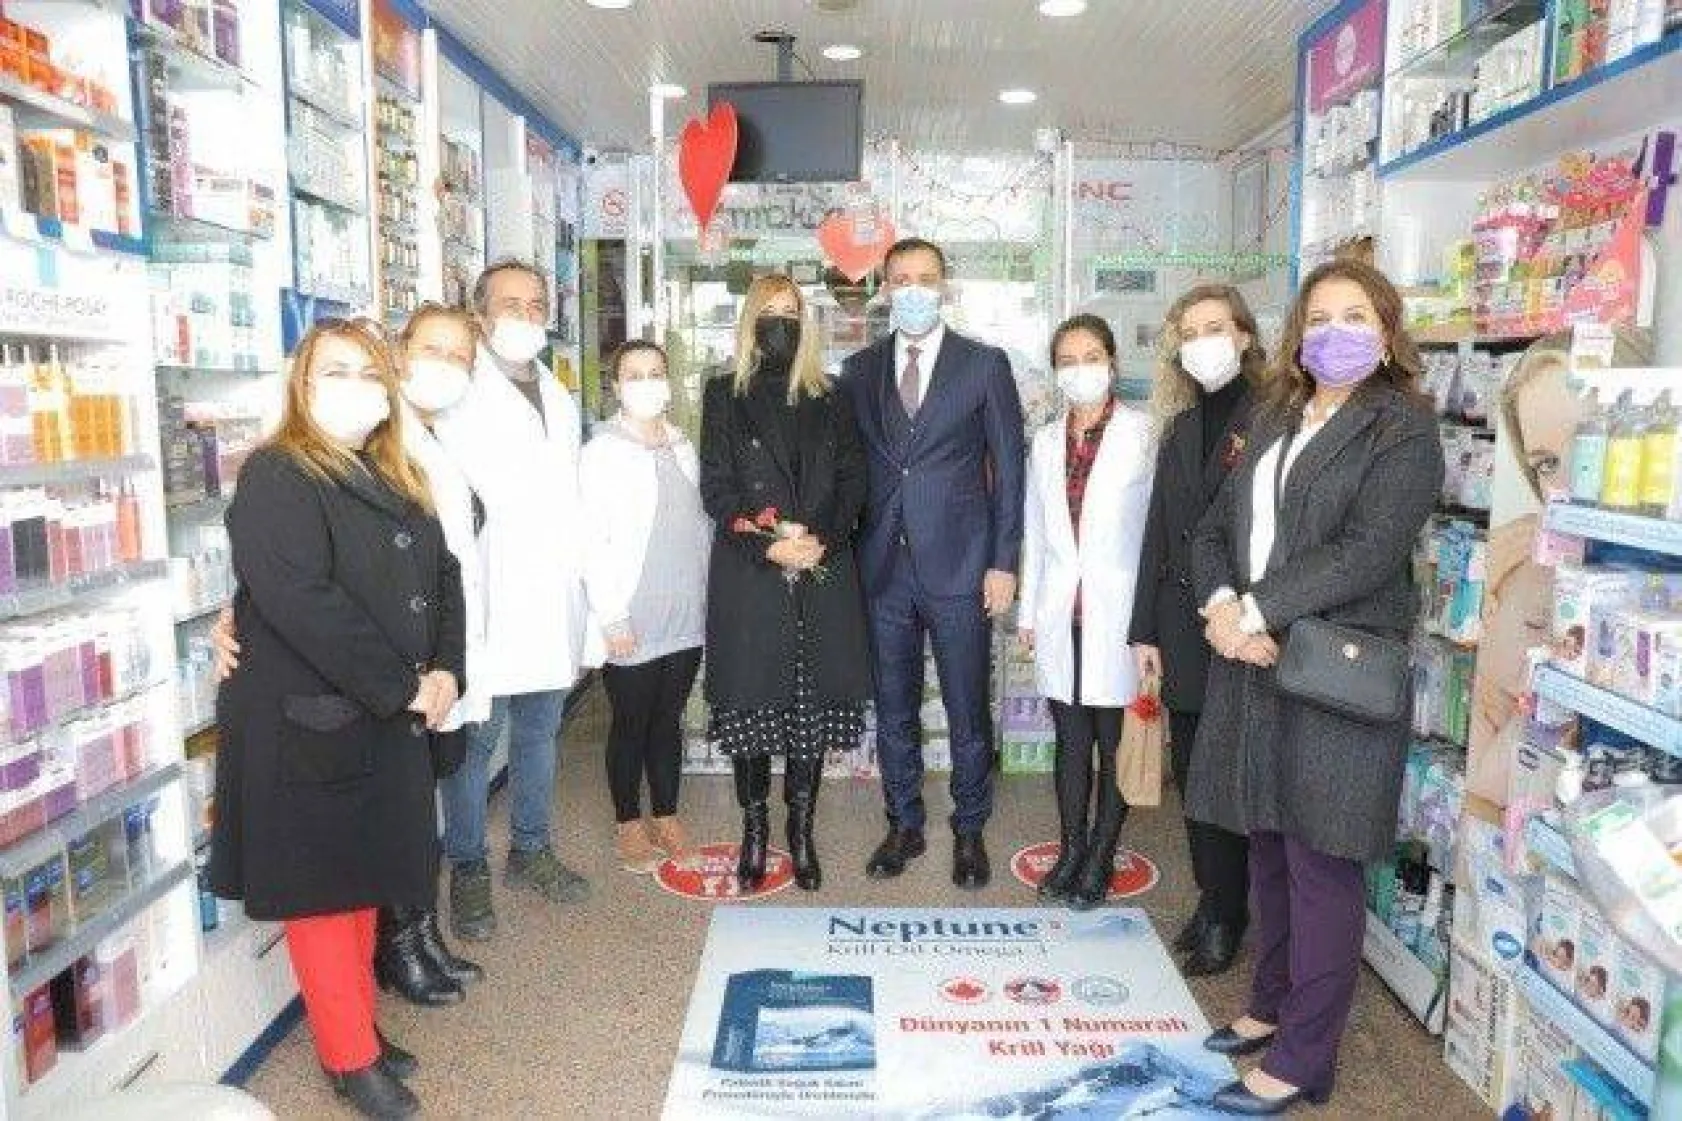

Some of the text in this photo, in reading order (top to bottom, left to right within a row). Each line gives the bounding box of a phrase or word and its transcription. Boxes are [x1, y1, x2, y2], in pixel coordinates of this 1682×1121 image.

[828, 916, 1038, 942] Neptune
[828, 943, 876, 954] Krill
[933, 943, 1024, 959] Omega
[899, 1016, 1189, 1035] Dünyanın 1 Numaralı
[988, 1038, 1115, 1058] Krill Yağı
